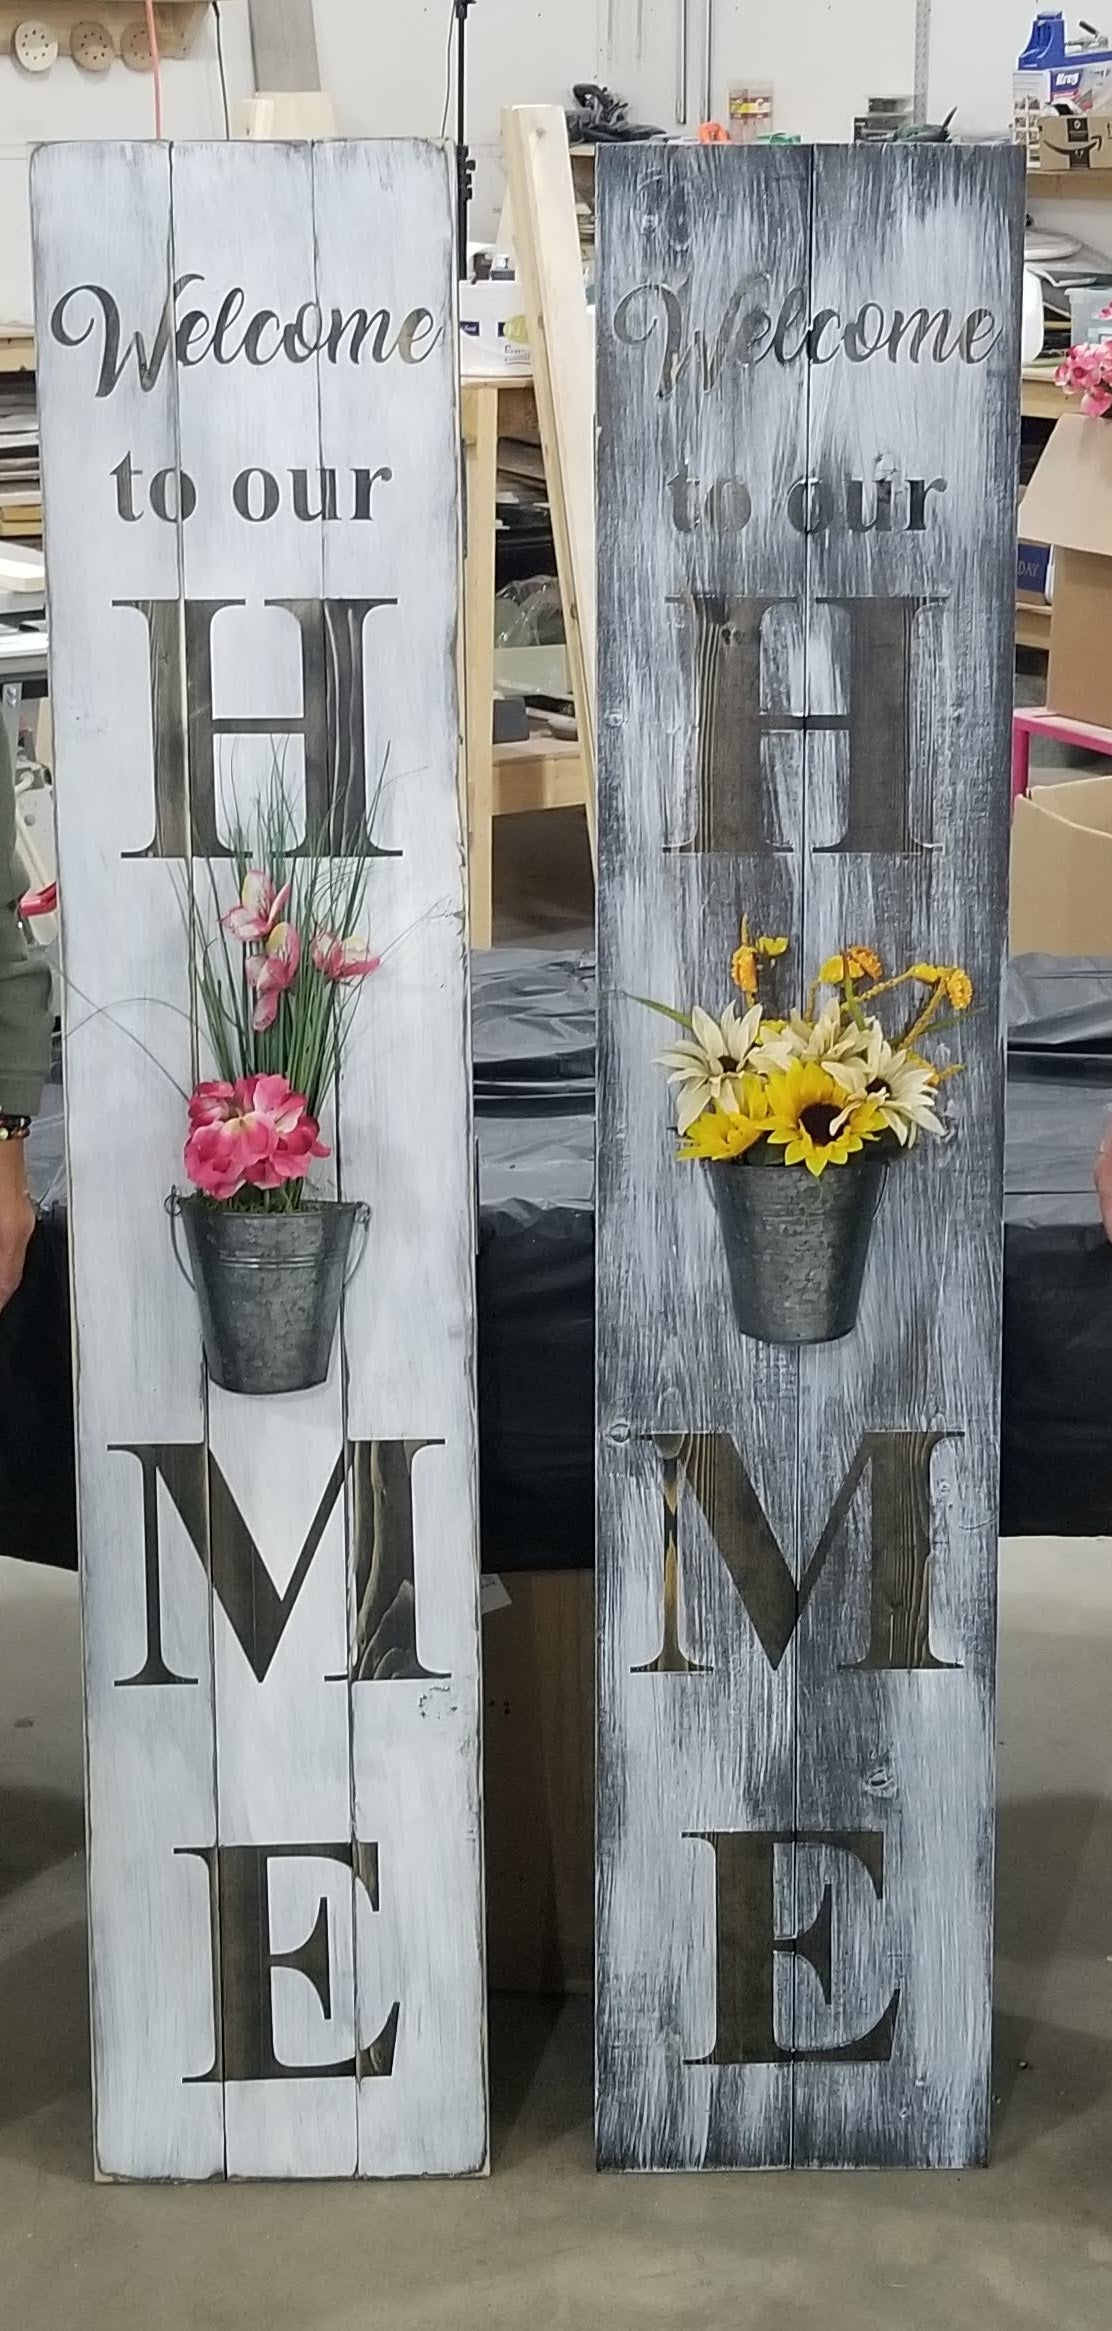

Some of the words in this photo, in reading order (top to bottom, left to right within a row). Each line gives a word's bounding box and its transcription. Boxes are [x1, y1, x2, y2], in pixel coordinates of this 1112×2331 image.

[50, 273, 444, 398] Welcome
[613, 272, 1001, 398] Welcome
[109, 450, 197, 523] to
[232, 465, 392, 522] our
[667, 461, 752, 533] to
[787, 476, 948, 533] our
[112, 598, 404, 858] H
[662, 595, 950, 854] H
[107, 1438, 452, 1686] M
[630, 1431, 965, 1673] M
[173, 1841, 400, 2084] E
[681, 1831, 900, 2065] E
